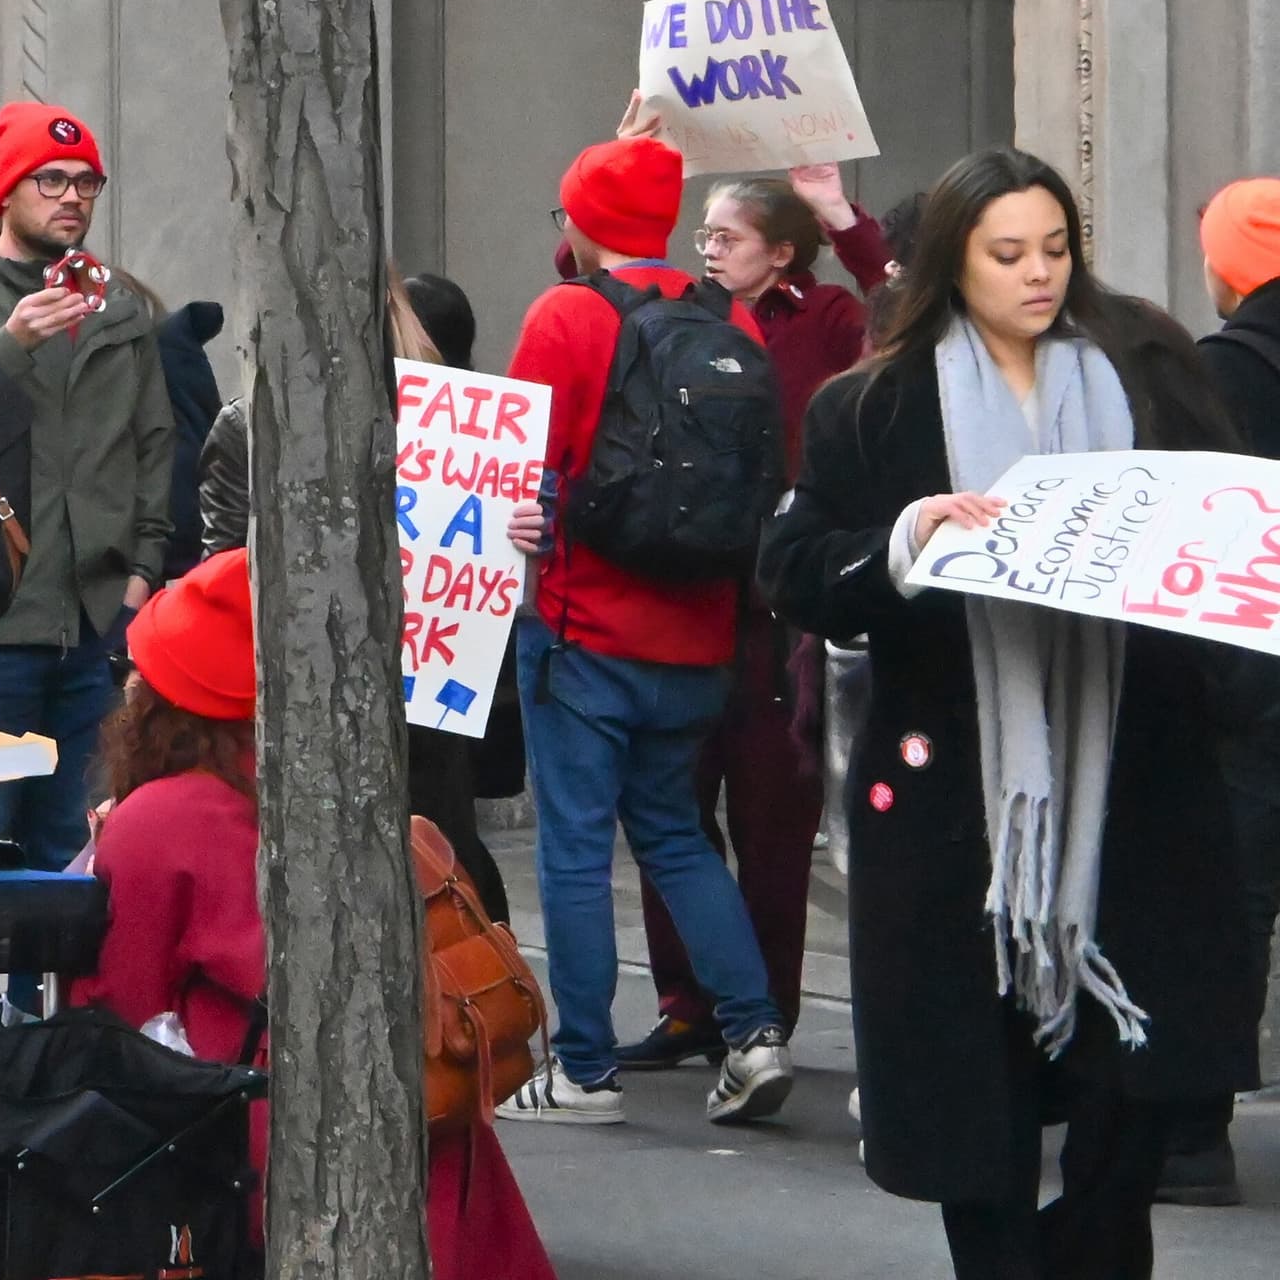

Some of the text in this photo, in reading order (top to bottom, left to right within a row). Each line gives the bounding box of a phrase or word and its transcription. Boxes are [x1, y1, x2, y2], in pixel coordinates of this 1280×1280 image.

[644, 2, 688, 50] WE
[667, 49, 802, 108] WORK
[396, 374, 531, 445] FAIR
[441, 447, 545, 503] WAGE
[440, 494, 483, 555] A
[422, 554, 520, 617] DAY'S
[1122, 540, 1217, 618] For
